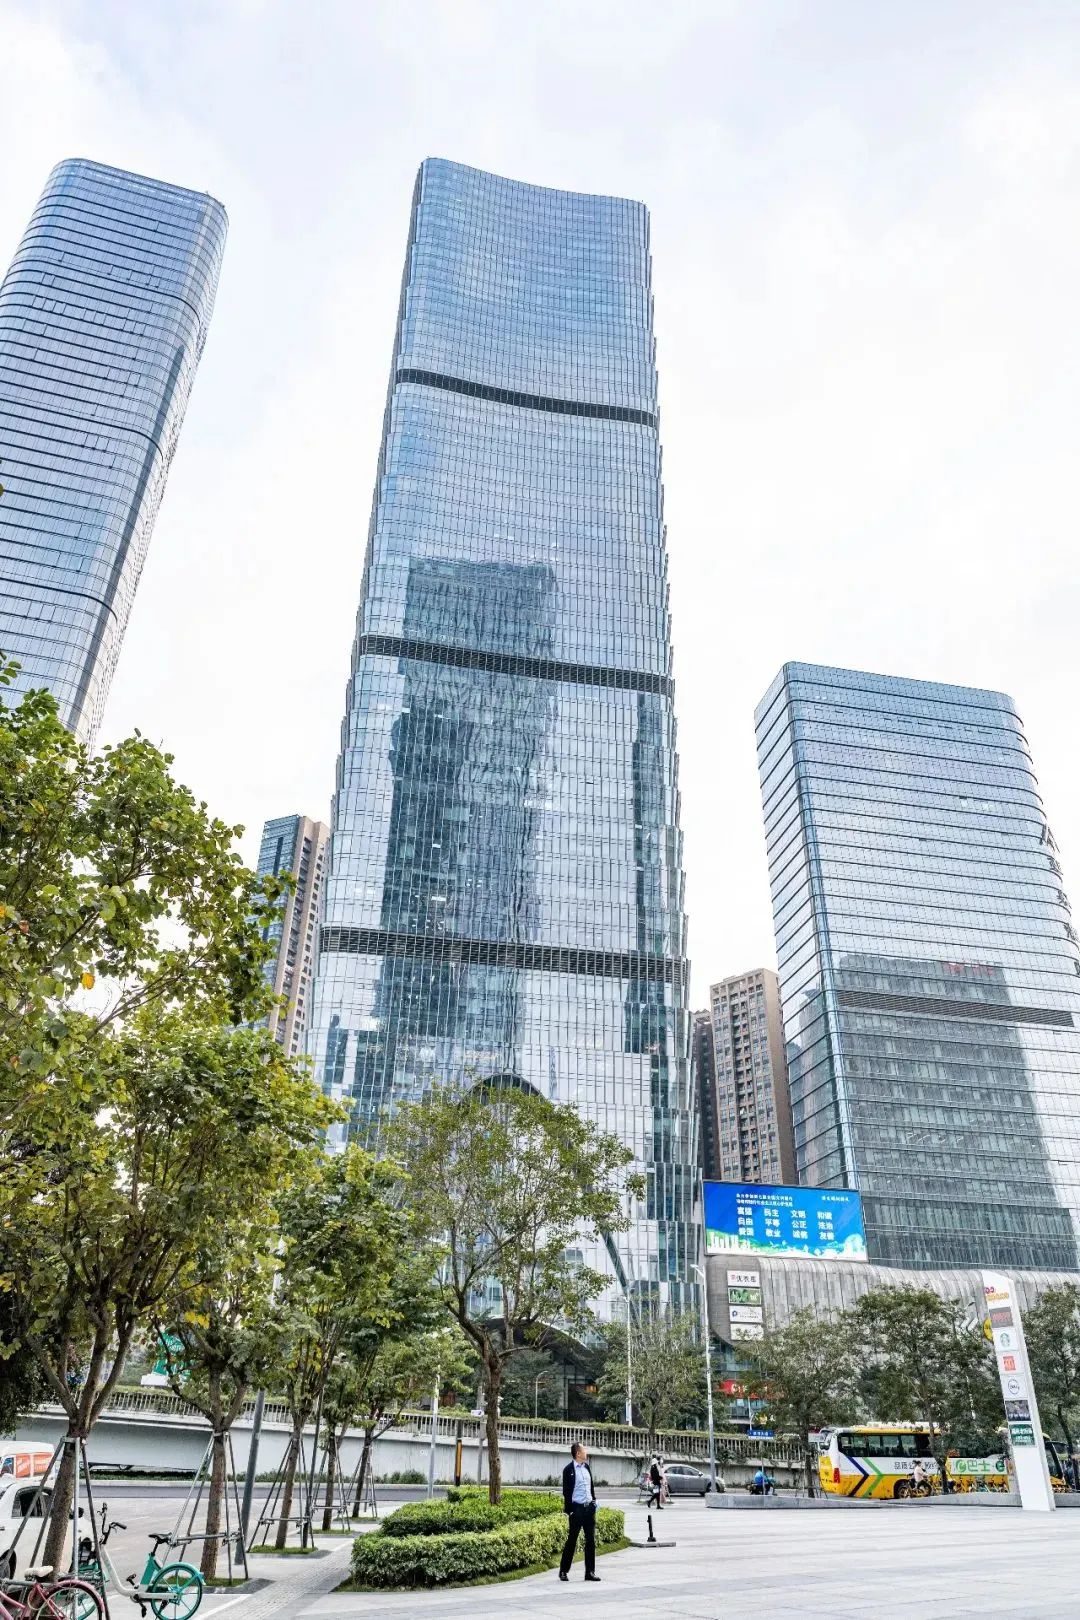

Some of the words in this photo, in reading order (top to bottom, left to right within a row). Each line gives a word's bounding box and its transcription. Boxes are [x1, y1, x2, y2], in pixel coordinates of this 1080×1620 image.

[764, 1208, 779, 1217] 民主
[790, 1209, 806, 1218] 文明
[817, 1211, 832, 1220] 和谐
[737, 1217, 753, 1226] 自由
[765, 1218, 780, 1227] 平等
[792, 1220, 807, 1229] 公正
[818, 1221, 833, 1230] 法治
[765, 1228, 781, 1238] 敬业
[792, 1230, 808, 1239] 诚信
[819, 1231, 835, 1241] 友善
